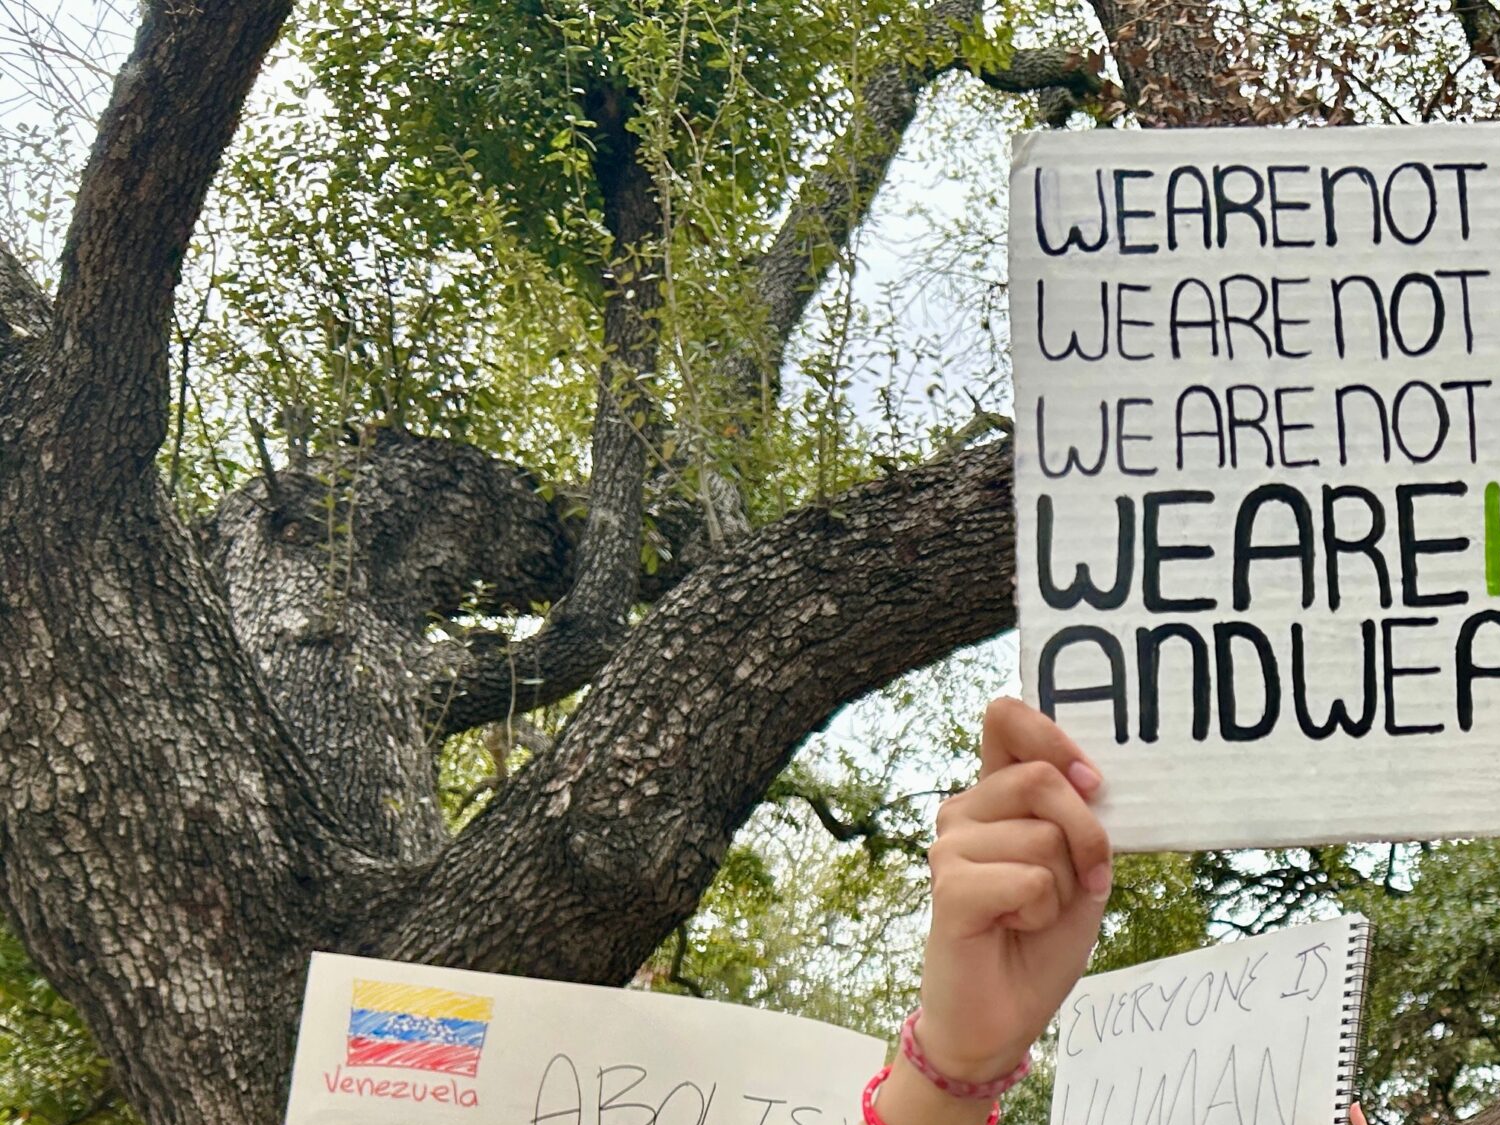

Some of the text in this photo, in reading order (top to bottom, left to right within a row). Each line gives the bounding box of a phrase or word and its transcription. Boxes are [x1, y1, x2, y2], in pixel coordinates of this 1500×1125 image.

[1035, 167, 1159, 256] WE
[1166, 164, 1316, 251] ARE
[1321, 162, 1488, 246] NOT
[1036, 278, 1155, 361] WE
[1169, 274, 1313, 360] ARE
[1331, 270, 1491, 359] NOT
[1036, 395, 1159, 479] WE
[1175, 384, 1320, 470] ARE
[1335, 378, 1493, 465] NOT
[1036, 490, 1218, 613] WE
[1232, 480, 1471, 612] ARE
[1037, 620, 1283, 745] AND
[1291, 616, 1446, 741] WE
[1065, 941, 1332, 1057] EVERYONE IS
[323, 1068, 480, 1109] Venezuela
